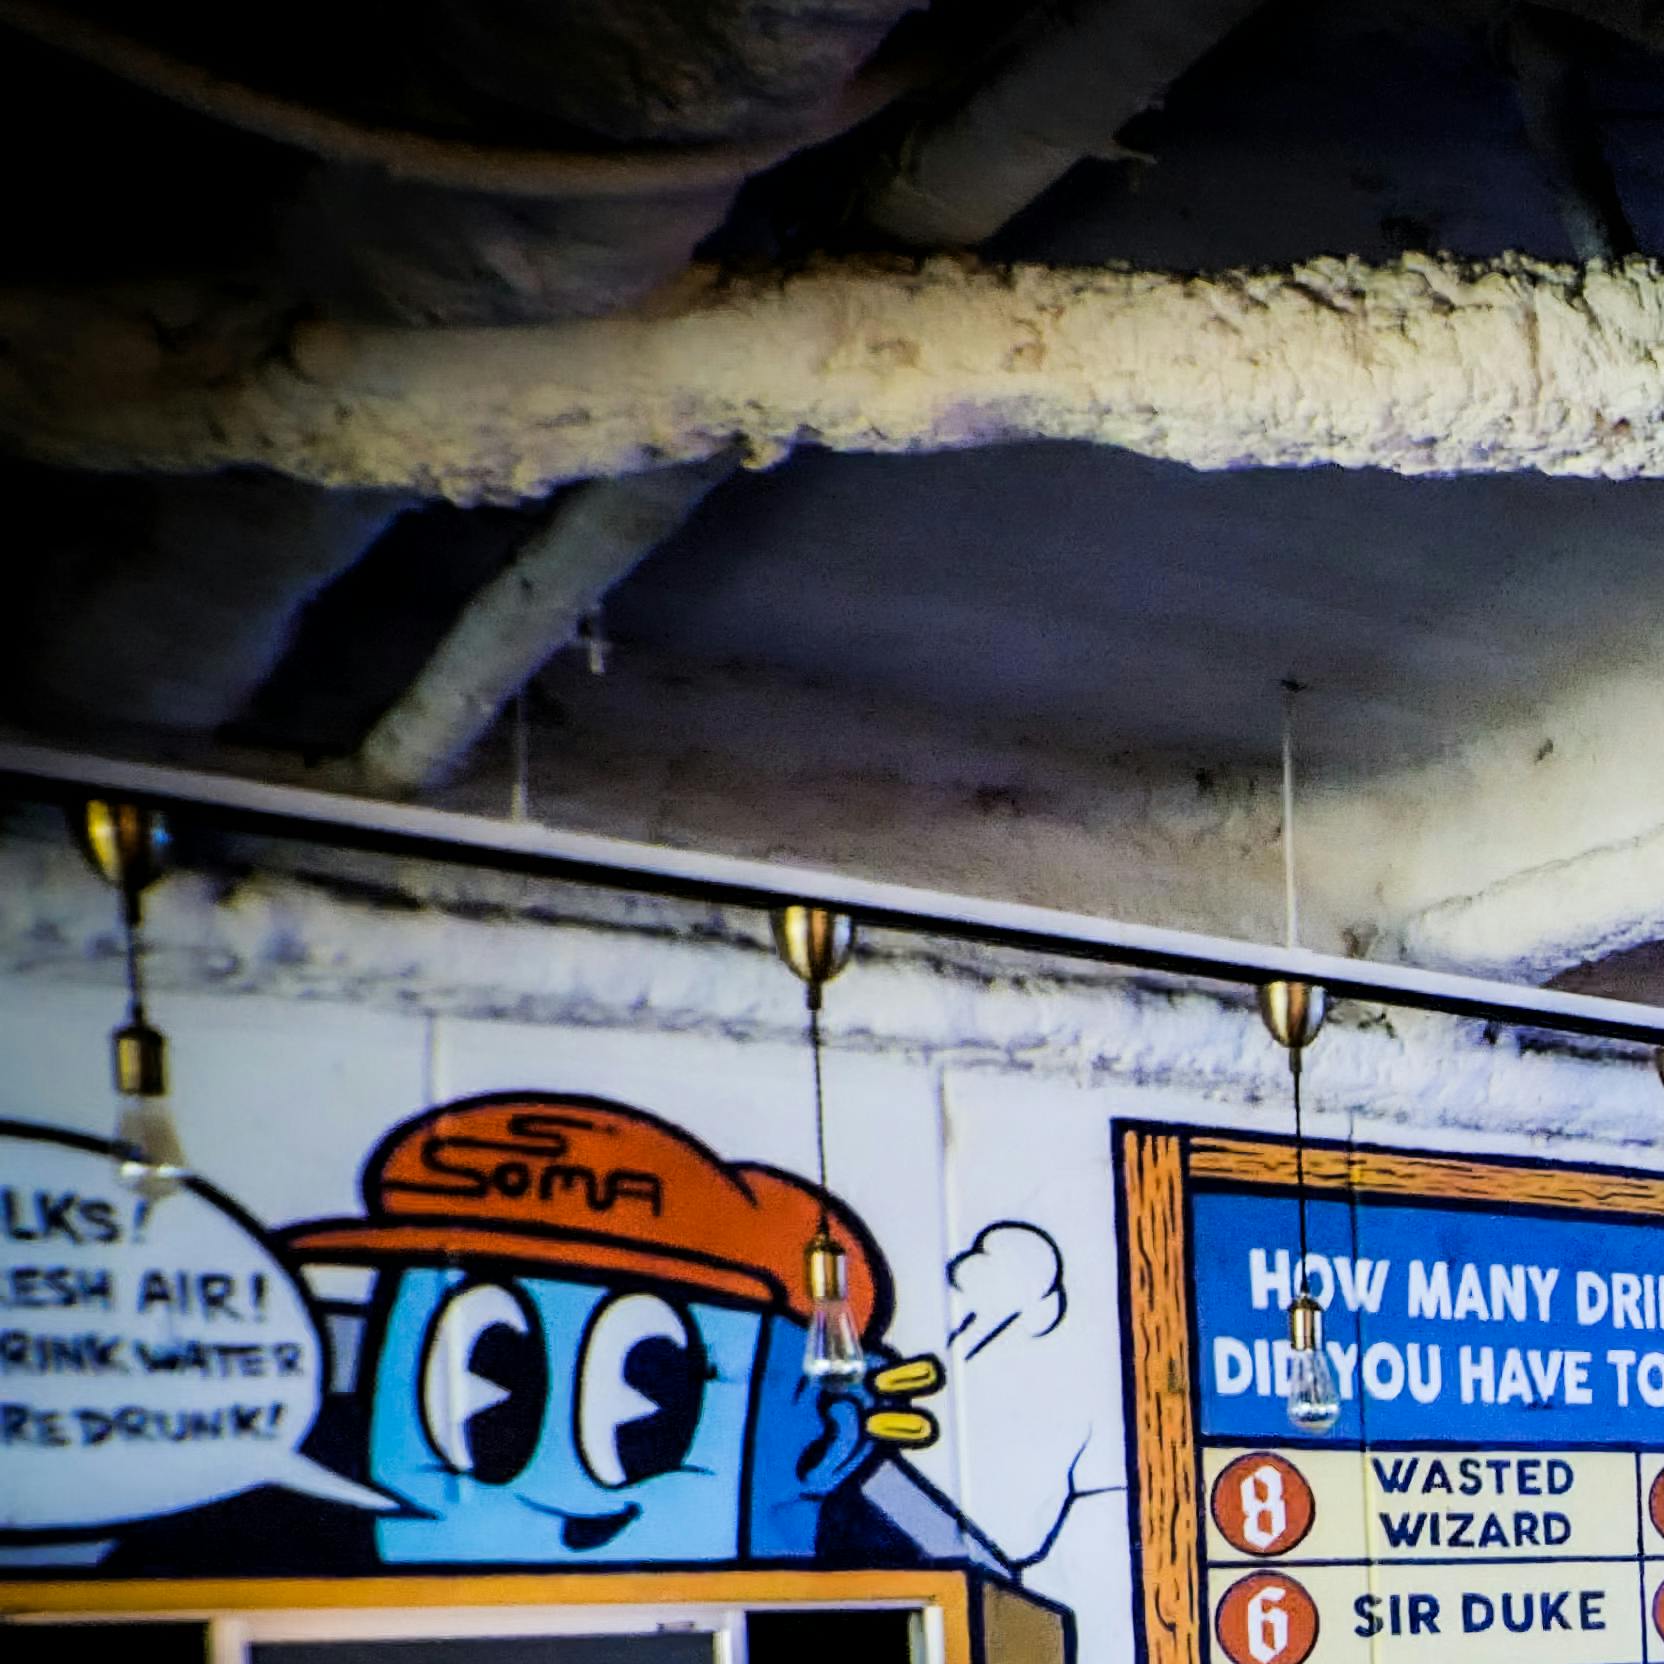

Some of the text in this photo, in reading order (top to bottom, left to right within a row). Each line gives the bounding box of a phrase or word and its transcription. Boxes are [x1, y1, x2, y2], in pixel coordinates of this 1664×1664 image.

[0, 1265, 267, 1322] ESH AIR!
[1250, 1248, 1390, 1314] HOW
[1408, 1260, 1559, 1322] MANY
[133, 1339, 304, 1377] WATER
[1326, 1341, 1442, 1403] YOU
[1459, 1345, 1592, 1406] HAVE
[1371, 1457, 1575, 1496] WASTED
[1240, 1464, 1287, 1551] 8
[1378, 1511, 1573, 1549] WIZARD
[1246, 1586, 1289, 1664] 6
[1353, 1590, 1608, 1638] SIR DUKE
